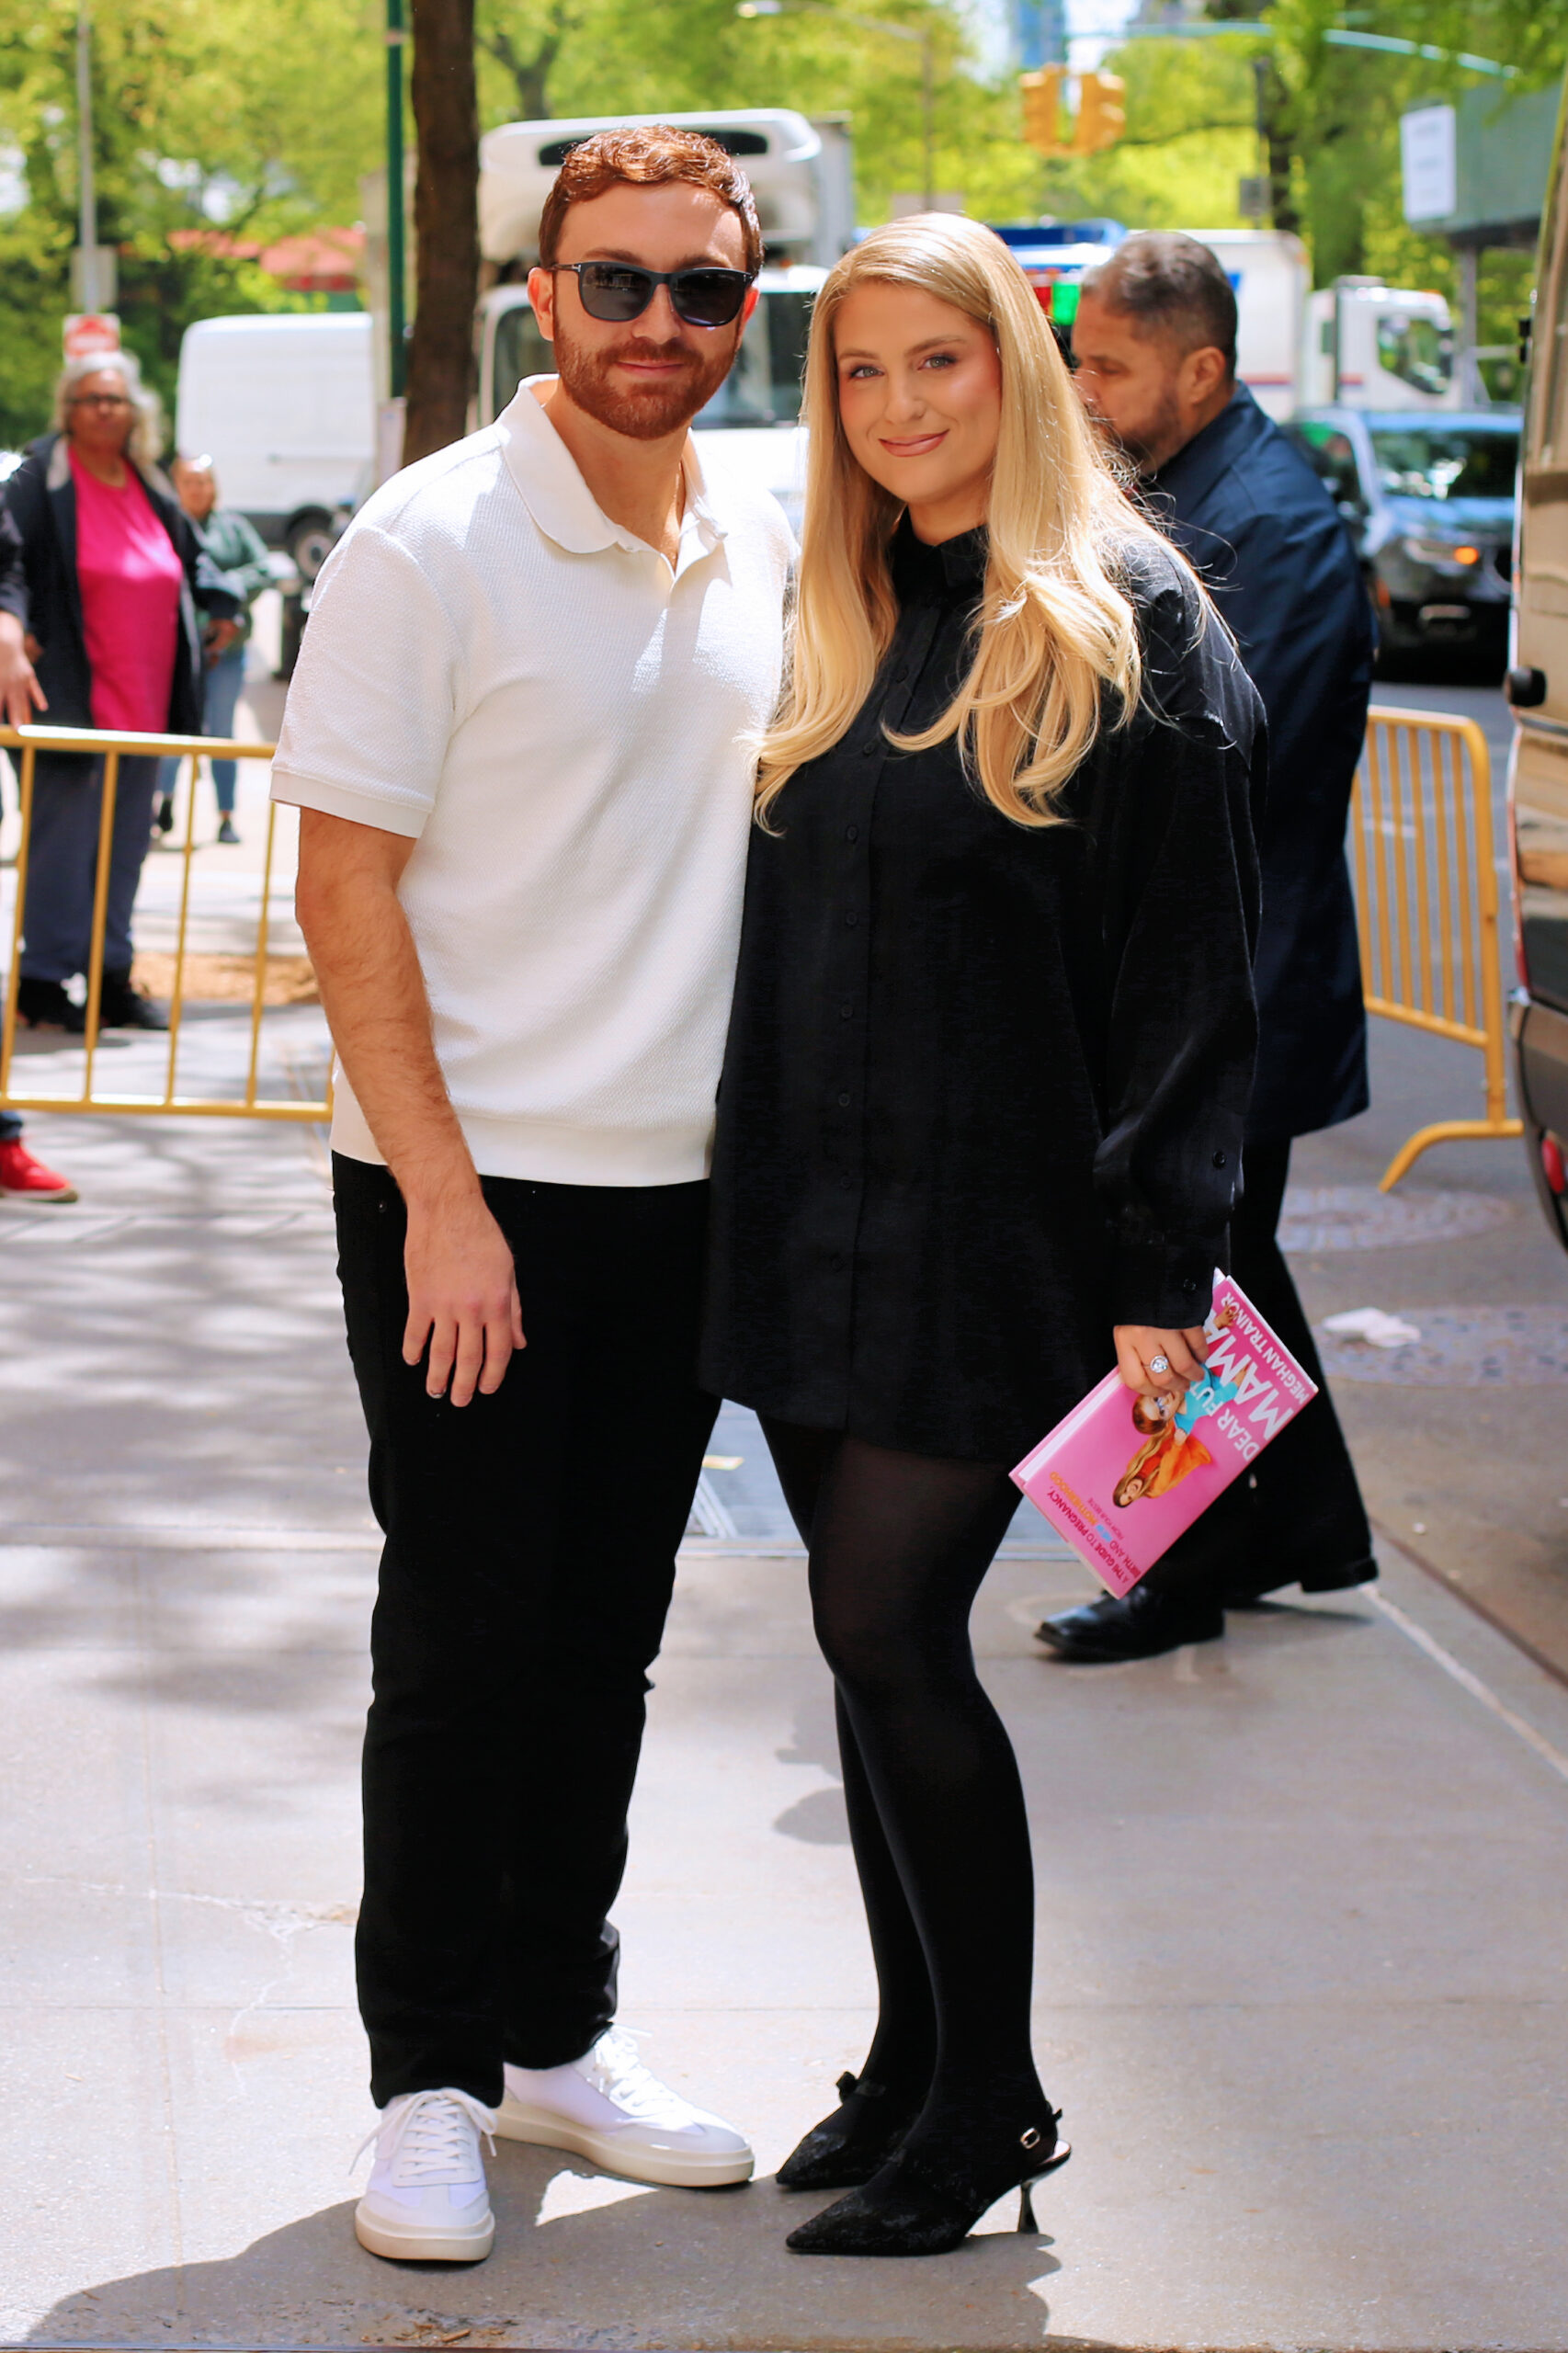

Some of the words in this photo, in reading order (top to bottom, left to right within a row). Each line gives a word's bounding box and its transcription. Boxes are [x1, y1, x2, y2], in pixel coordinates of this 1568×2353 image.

[1219, 1291, 1270, 1352] TRAINOR
[1188, 1380, 1224, 1416] FUT
[1201, 1308, 1295, 1441] MAMA
[1261, 1347, 1311, 1404] MEGHAN
[1215, 1408, 1261, 1461] DEAR
[1085, 1532, 1098, 1547] TO
[1094, 1542, 1115, 1567] GUIDE
